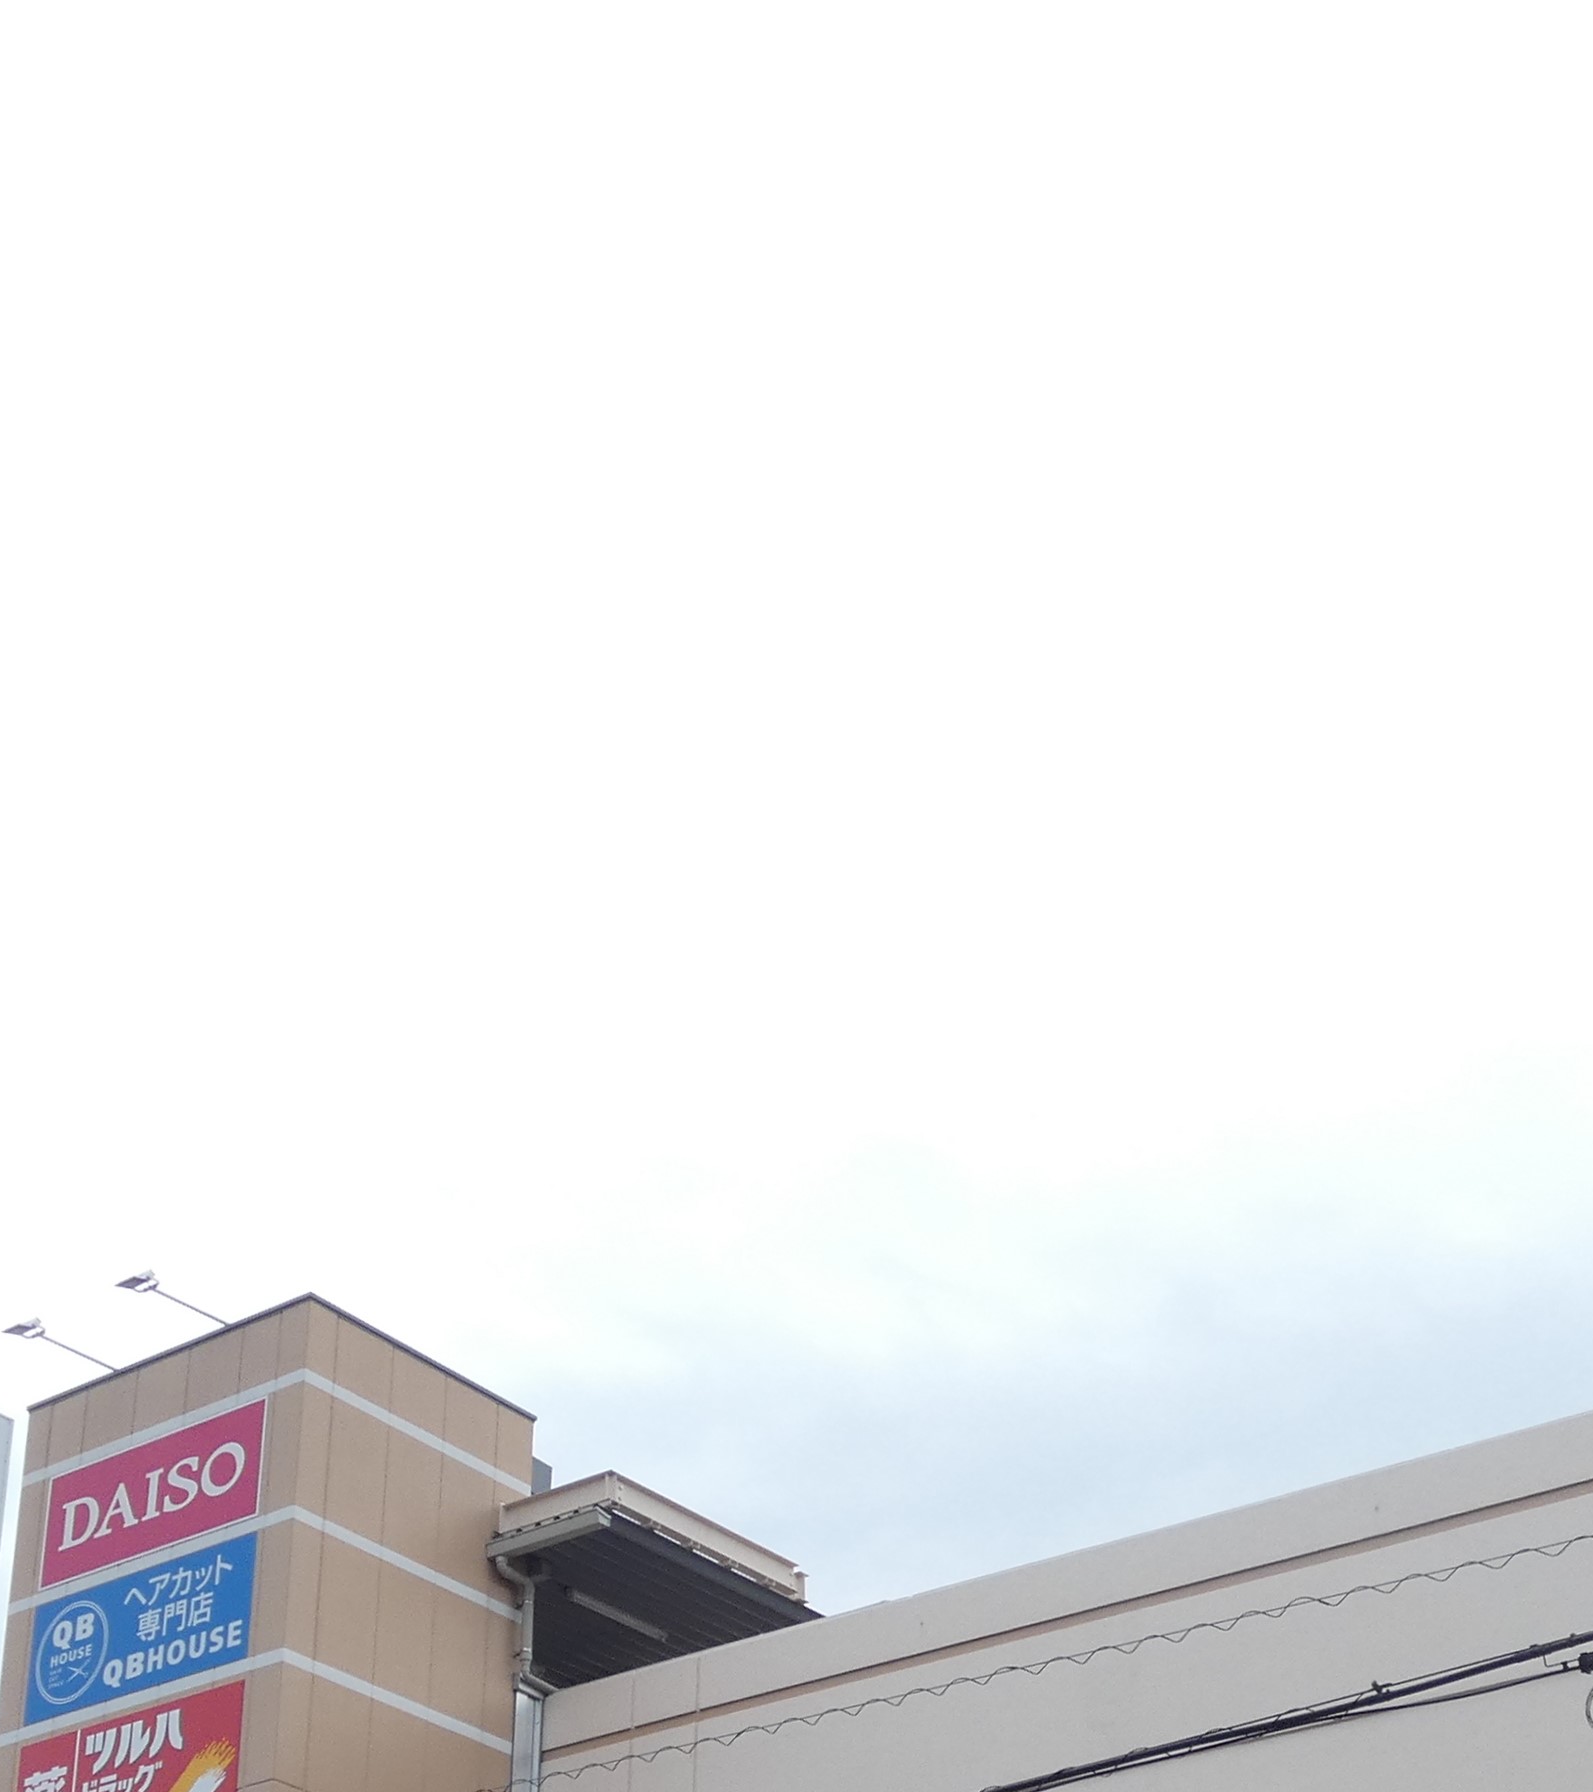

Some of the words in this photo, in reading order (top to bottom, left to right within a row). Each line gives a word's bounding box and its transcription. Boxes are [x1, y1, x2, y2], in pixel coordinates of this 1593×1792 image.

[58, 1442, 245, 1552] DAISO
[124, 1555, 233, 1607] ヘアカット
[53, 1613, 95, 1650] QB
[136, 1593, 214, 1642] 専門店
[50, 1644, 93, 1669] HOUSE
[84, 1708, 184, 1774] ツルハ
